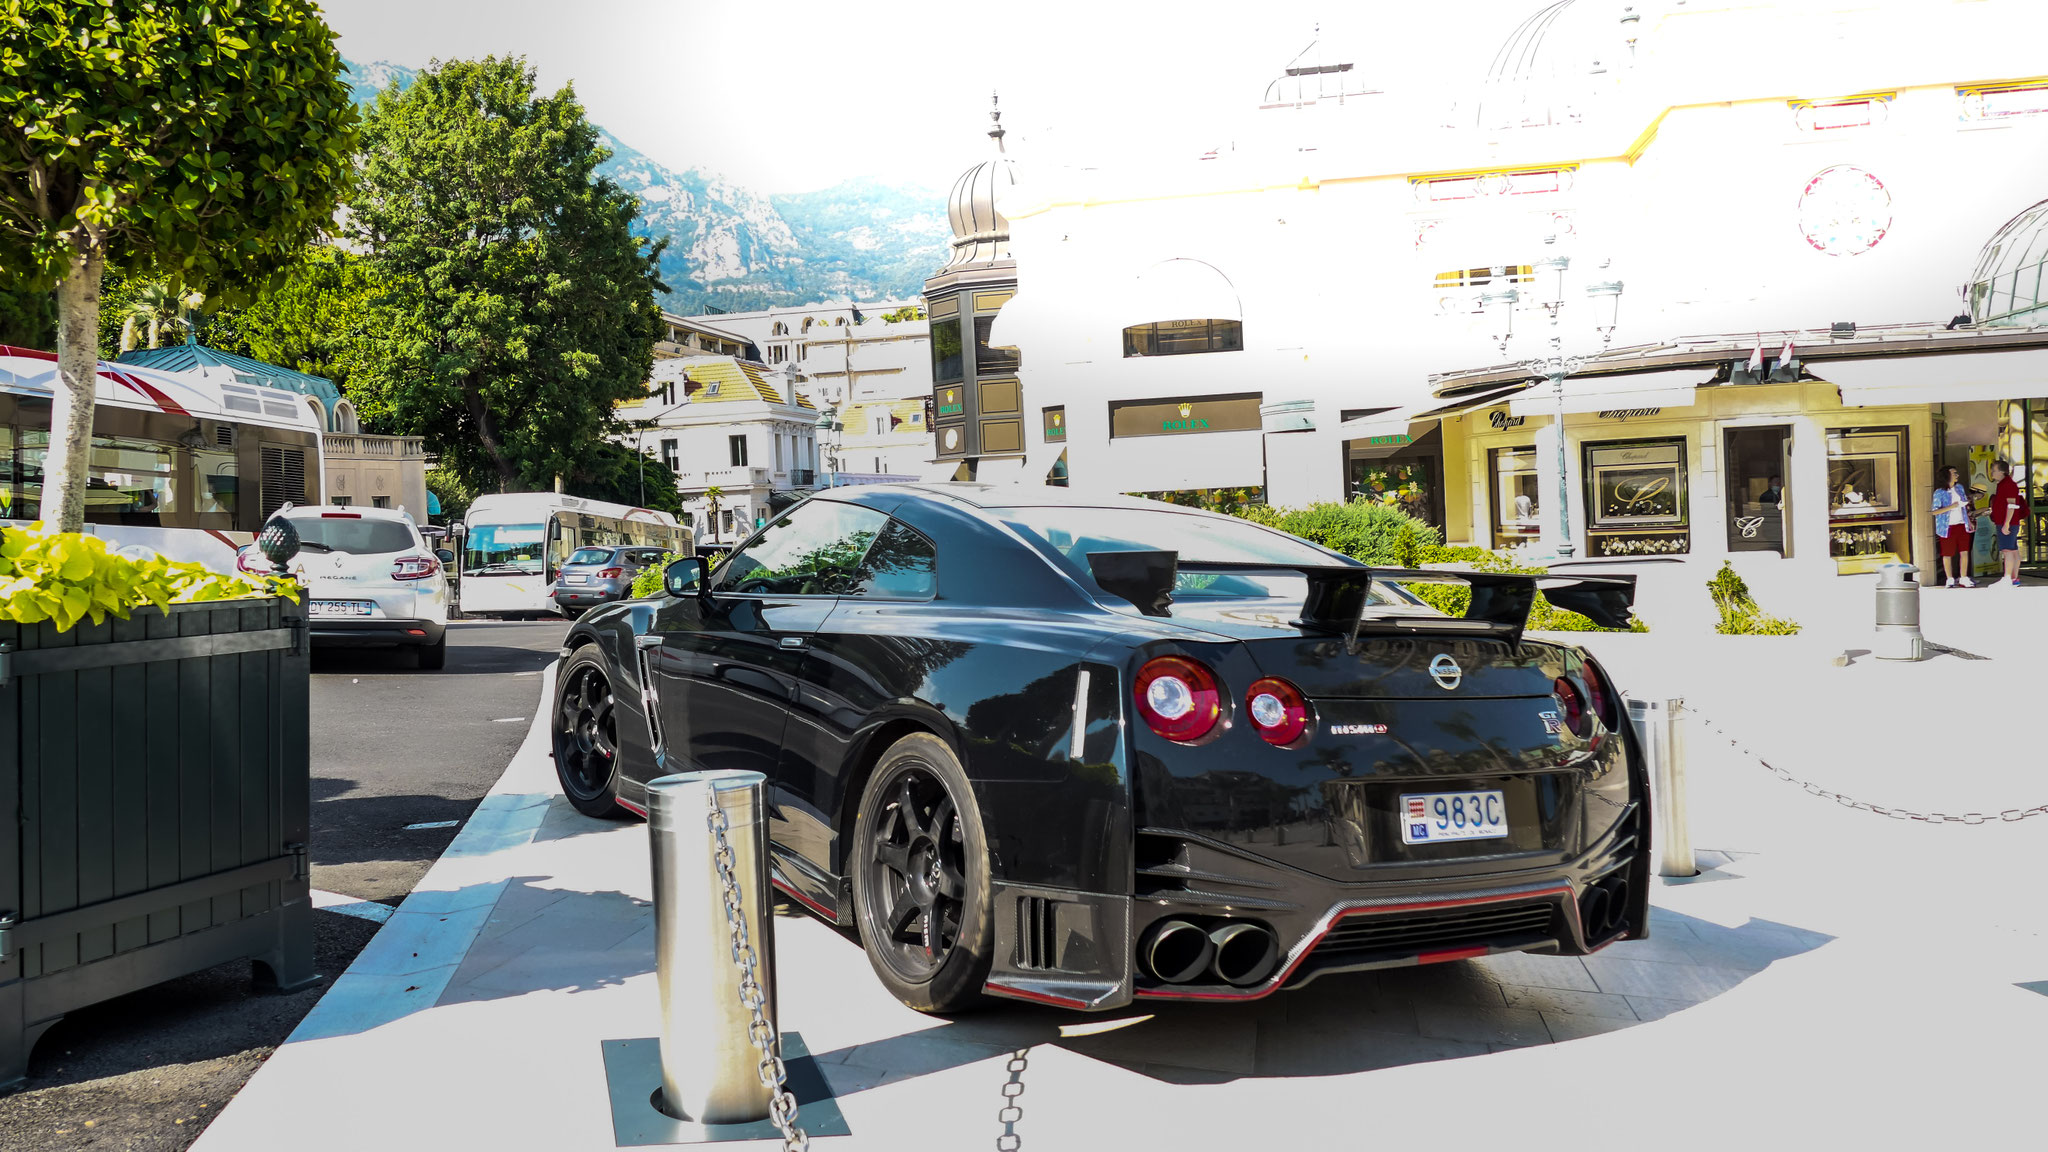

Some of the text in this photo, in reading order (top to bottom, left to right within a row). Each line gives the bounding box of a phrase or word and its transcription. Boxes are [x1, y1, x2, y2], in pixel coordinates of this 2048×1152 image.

[940, 403, 962, 413] ROLEX
[1162, 419, 1209, 431] ROLEX
[1046, 427, 1066, 436] ROLE
[1371, 434, 1413, 445] ROLEX
[1434, 794, 1500, 830] 983C
[1413, 825, 1426, 836] MC
